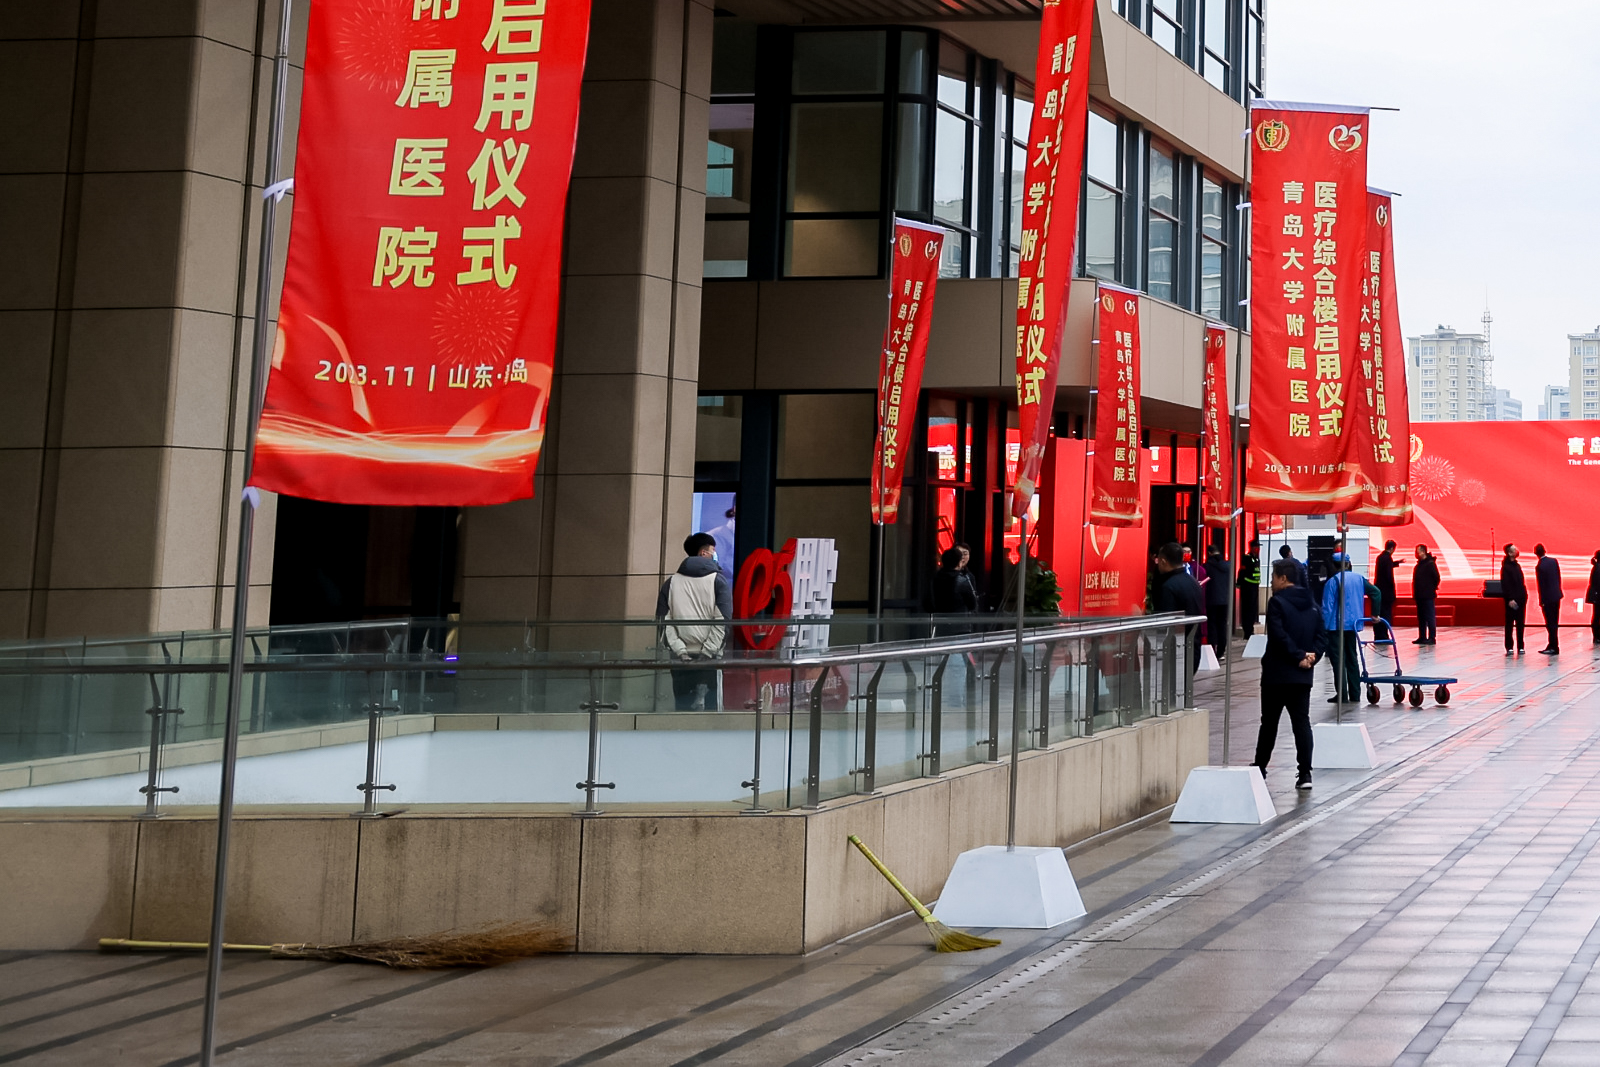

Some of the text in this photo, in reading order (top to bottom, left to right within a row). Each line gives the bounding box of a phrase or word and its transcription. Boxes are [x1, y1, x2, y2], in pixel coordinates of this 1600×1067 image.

[1113, 330, 1127, 482] 青岛大学附属医院
[1123, 331, 1137, 483] 医疗综合楼启用仪式
[1282, 181, 1311, 437] 青岛大学附属医院
[1312, 181, 1345, 437] 医疗综合楼启用仪式
[1370, 251, 1395, 464] 医疗综合楼启用仪式
